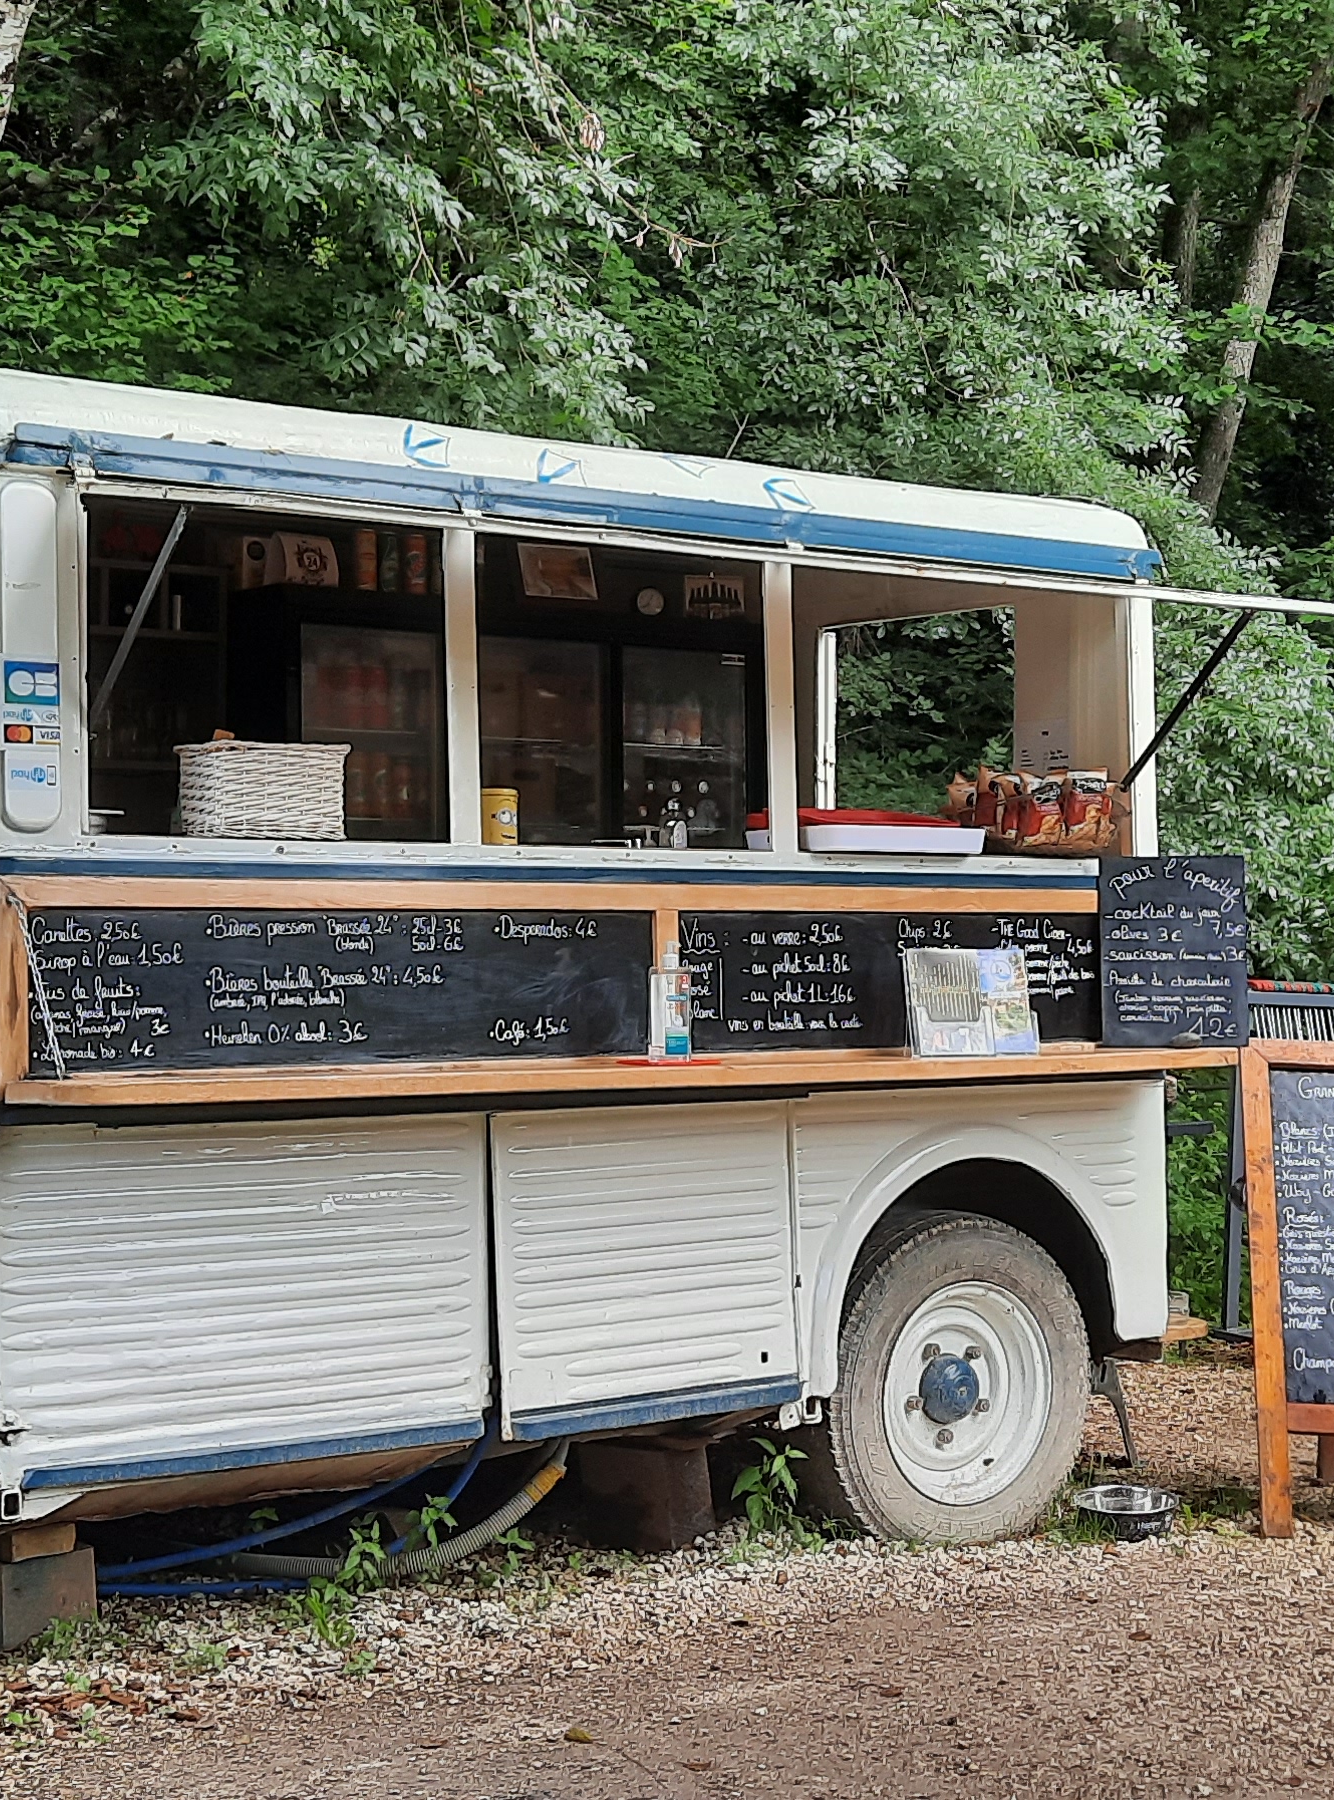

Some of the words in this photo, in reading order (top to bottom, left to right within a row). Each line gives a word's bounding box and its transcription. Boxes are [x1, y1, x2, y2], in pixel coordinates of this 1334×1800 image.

[40, 731, 61, 740] VISA
[1109, 865, 1156, 900] pour
[1180, 906, 1194, 919] du
[1193, 907, 1222, 926] jour
[267, 920, 316, 946] pression
[575, 917, 598, 939] 4€
[1157, 927, 1183, 942] 3€
[82, 950, 93, 967] à
[1225, 946, 1247, 962] 3€
[71, 977, 90, 1000] de
[1151, 972, 1164, 986] de
[151, 1018, 170, 1036] 3€
[753, 1019, 764, 1031] en
[828, 1011, 838, 1028] la
[1188, 1016, 1238, 1038] 12€
[268, 1023, 291, 1043] 0%
[339, 1019, 368, 1044] 3€
